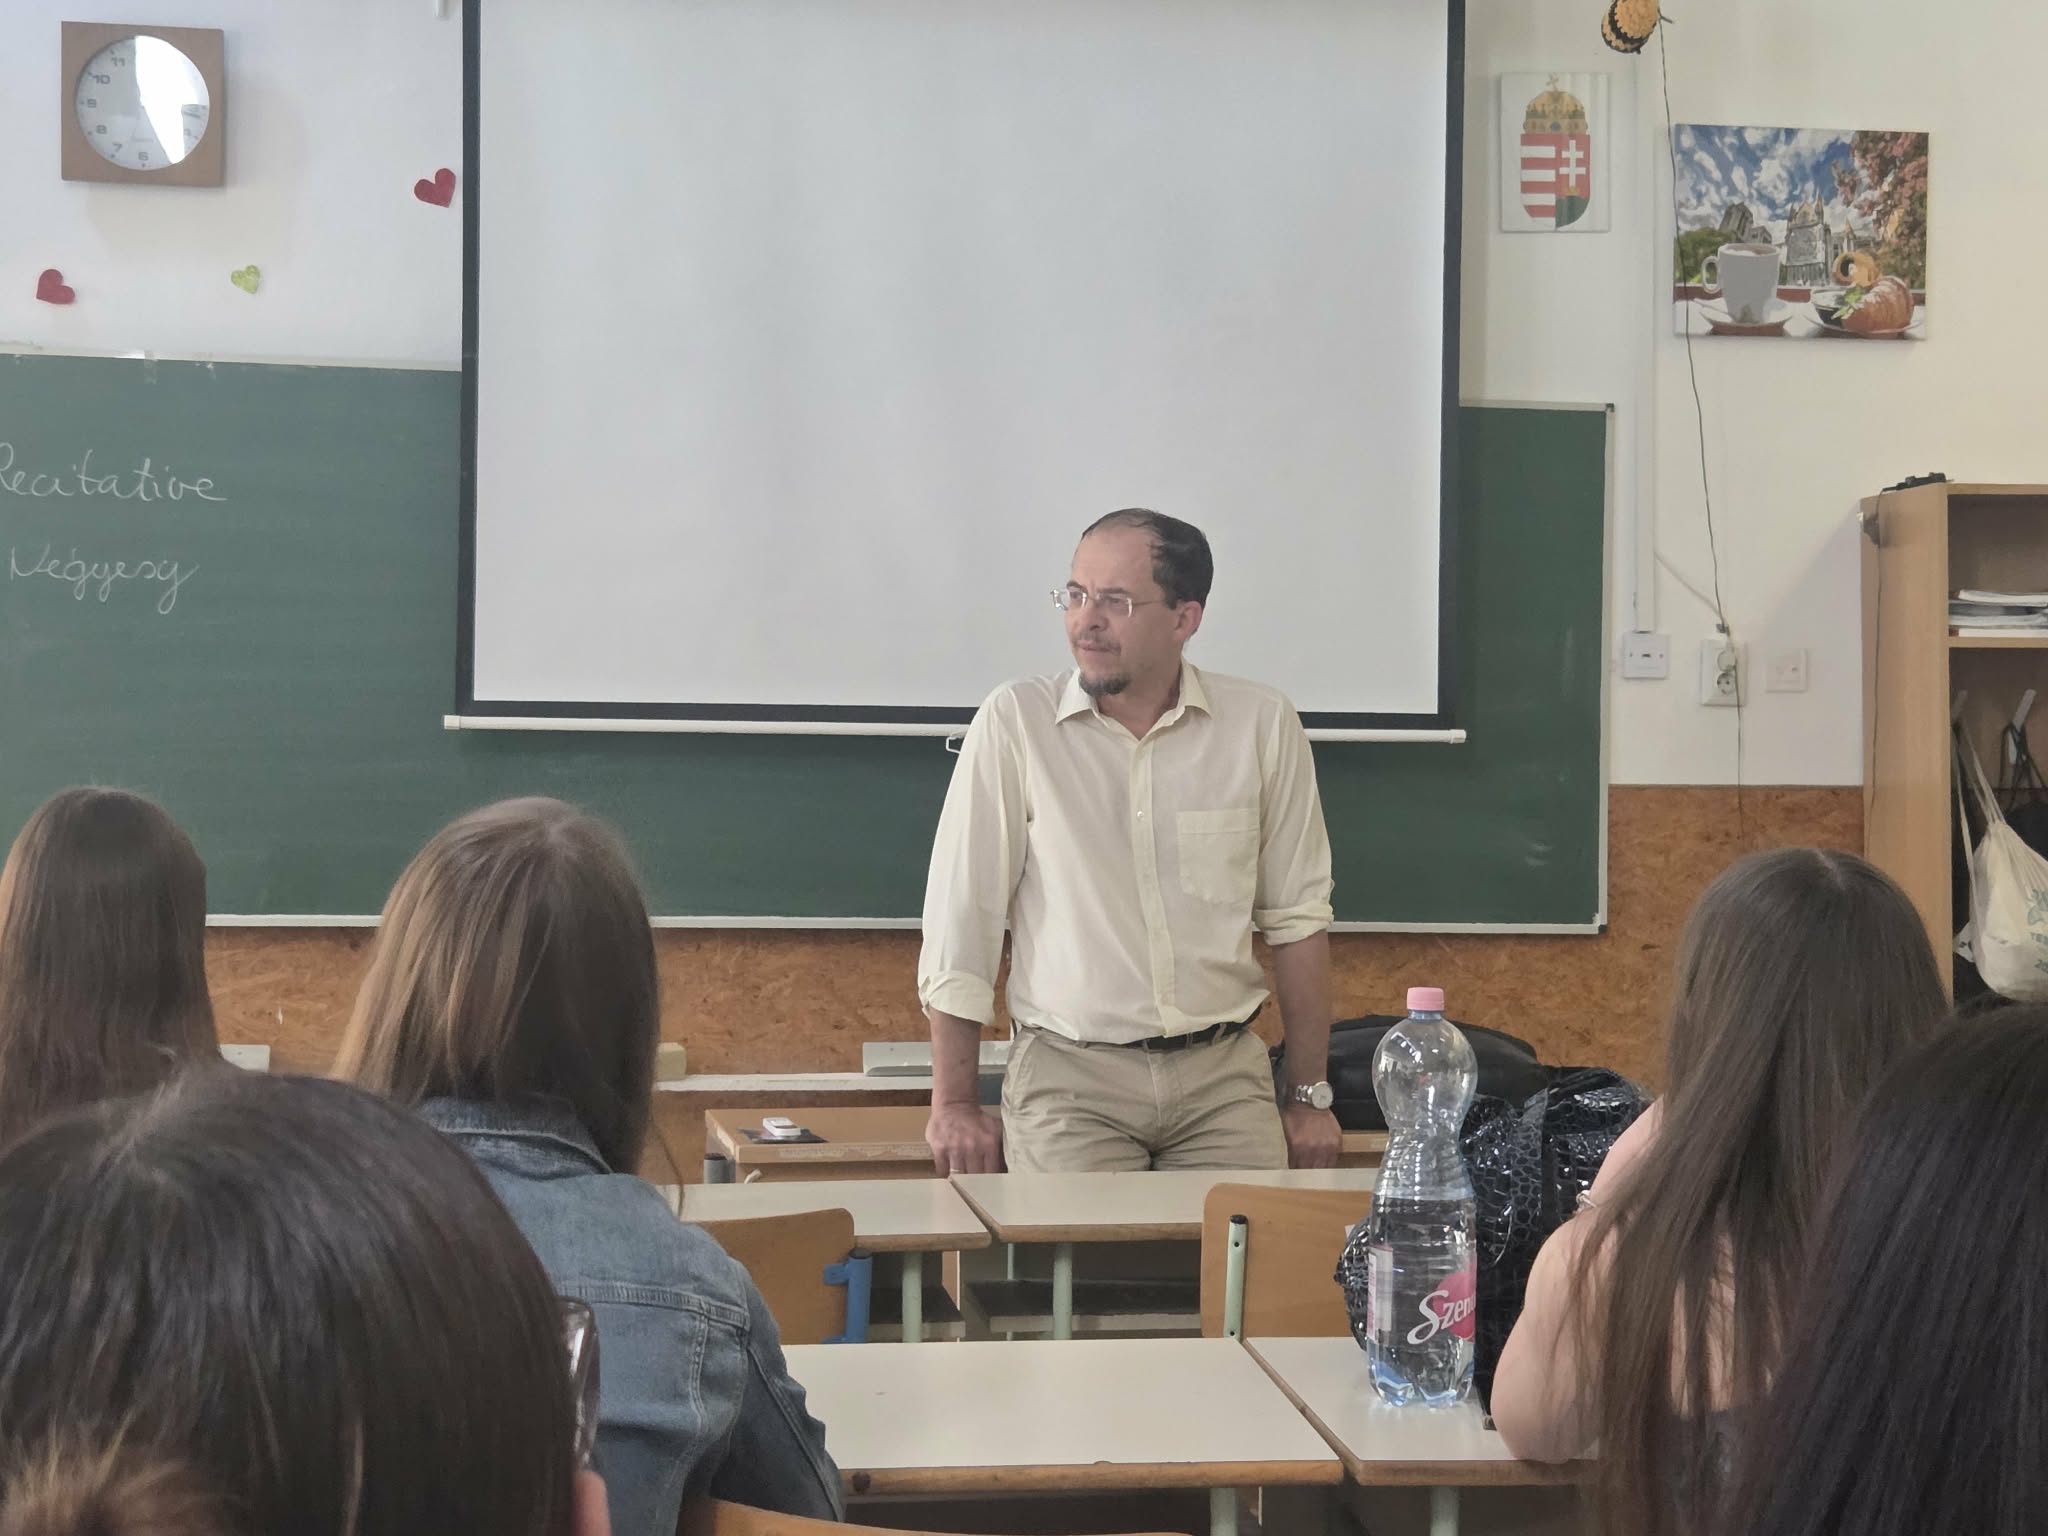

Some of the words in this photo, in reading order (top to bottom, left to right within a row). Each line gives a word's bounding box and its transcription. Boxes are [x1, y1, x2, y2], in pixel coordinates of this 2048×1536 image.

[111, 57, 125, 67] 11
[92, 74, 111, 84] 10
[87, 99, 97, 108] 9
[96, 125, 107, 134] 8
[112, 143, 123, 152] 7
[138, 152, 148, 161] 6
